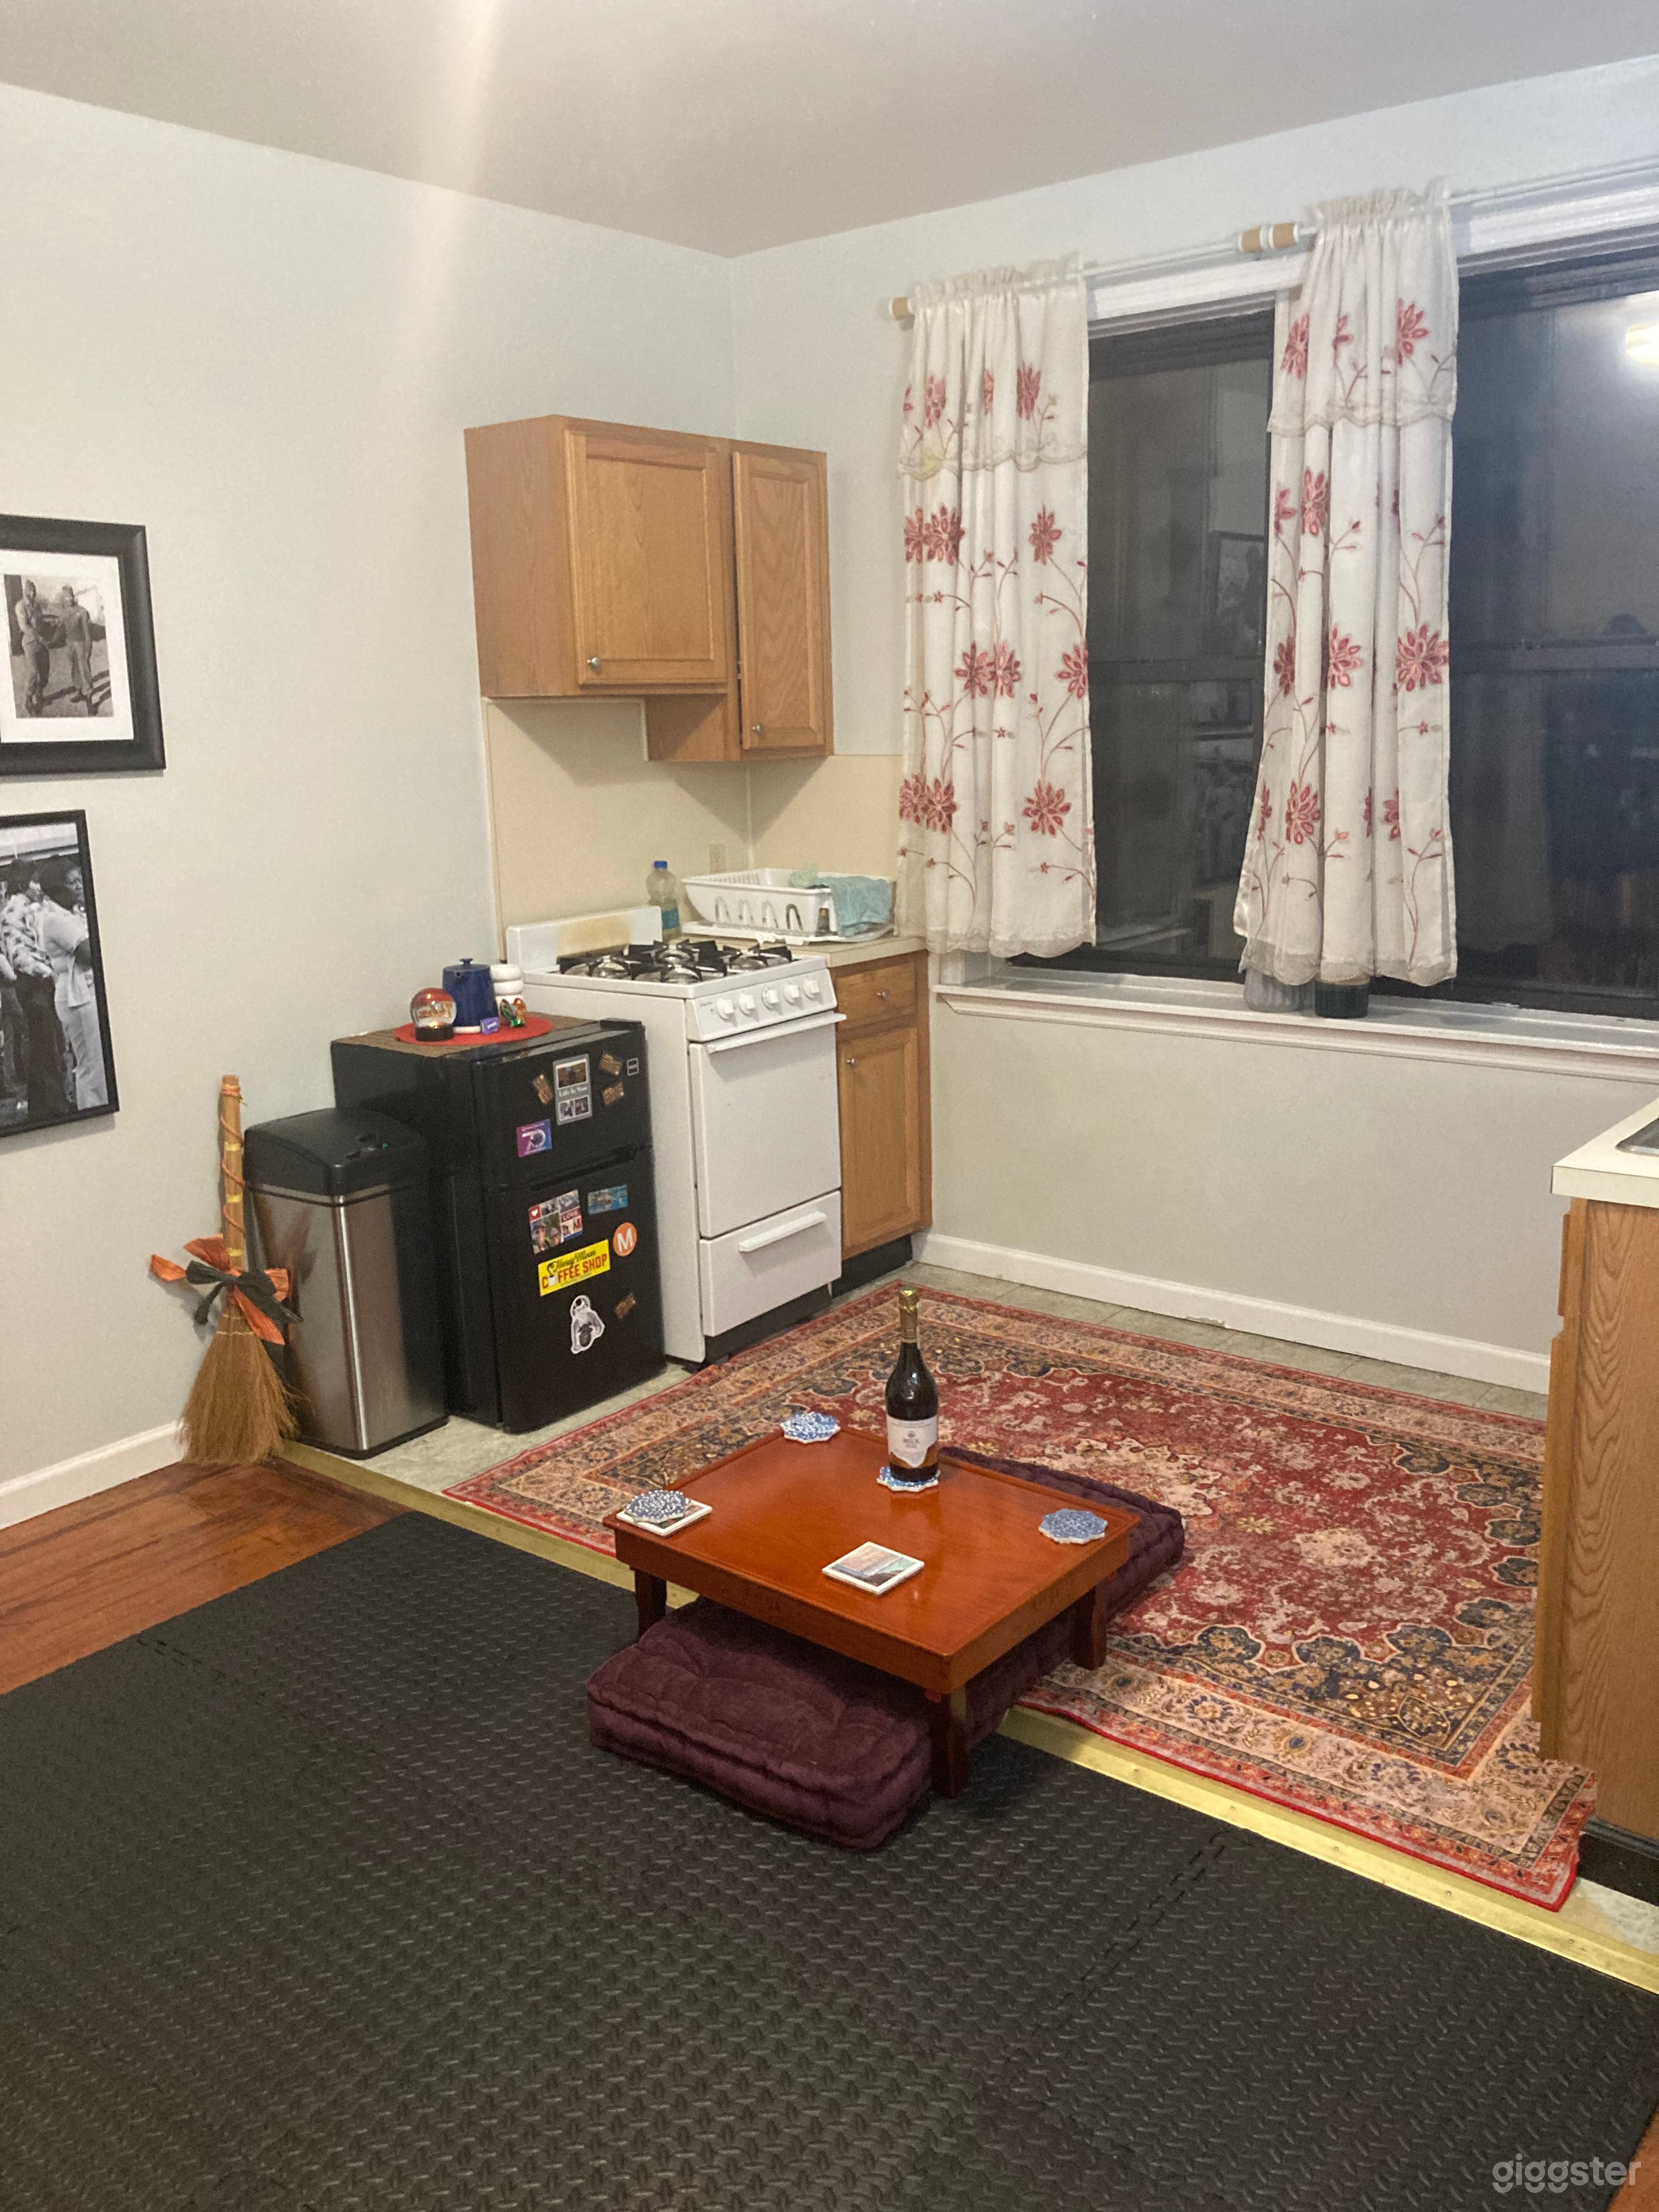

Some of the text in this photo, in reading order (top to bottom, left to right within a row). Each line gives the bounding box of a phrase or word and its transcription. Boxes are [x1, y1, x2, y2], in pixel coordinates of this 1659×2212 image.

[617, 1228, 633, 1253] M
[542, 1264, 580, 1289] CFFEE
[582, 1253, 607, 1273] SHOP
